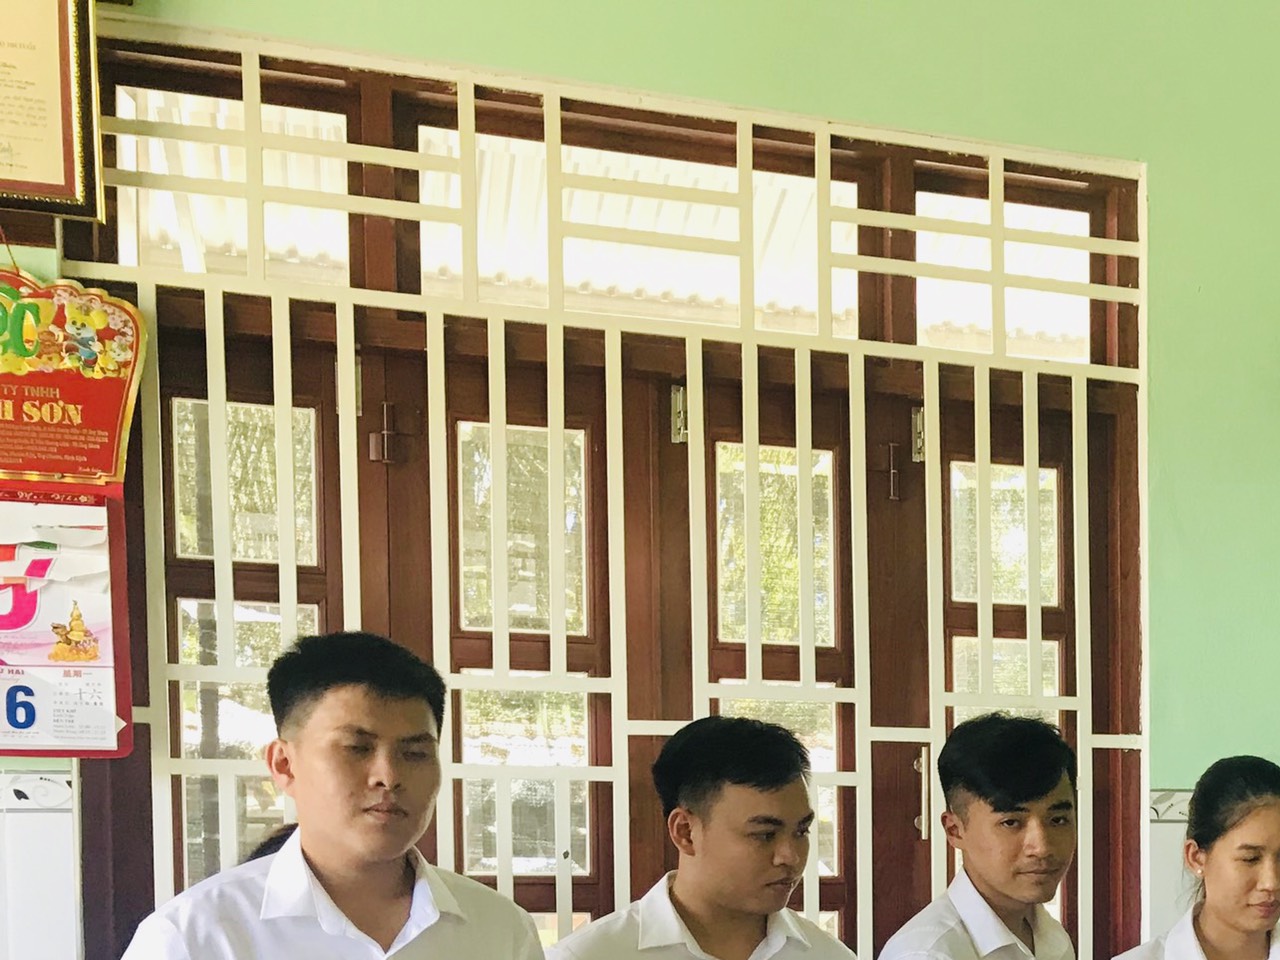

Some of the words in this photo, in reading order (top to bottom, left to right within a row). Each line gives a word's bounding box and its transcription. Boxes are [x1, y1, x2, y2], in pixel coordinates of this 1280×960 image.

[1, 384, 18, 396] TY
[21, 385, 60, 399] TNHH
[22, 399, 84, 426] SƠN
